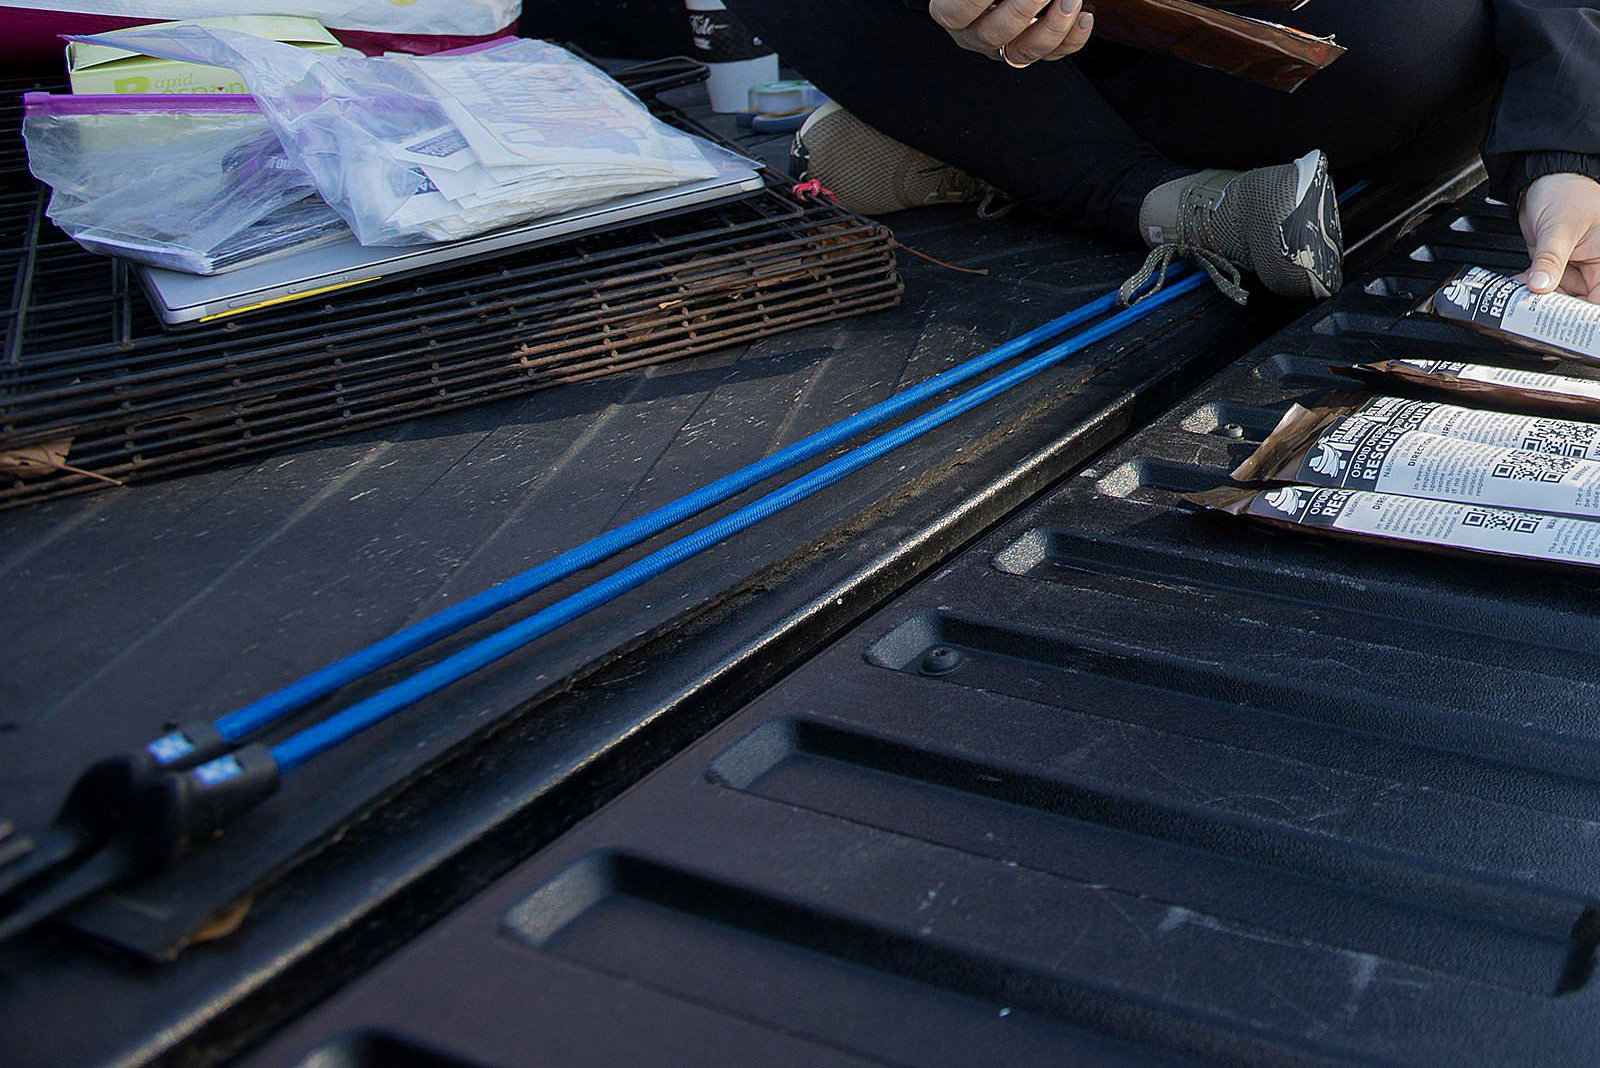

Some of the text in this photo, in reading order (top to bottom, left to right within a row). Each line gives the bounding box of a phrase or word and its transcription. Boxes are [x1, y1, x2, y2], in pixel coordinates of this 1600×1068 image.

[1352, 446, 1372, 477] OPIOID
[1363, 432, 1401, 480] RESCUE
[1321, 491, 1355, 517] RESC
